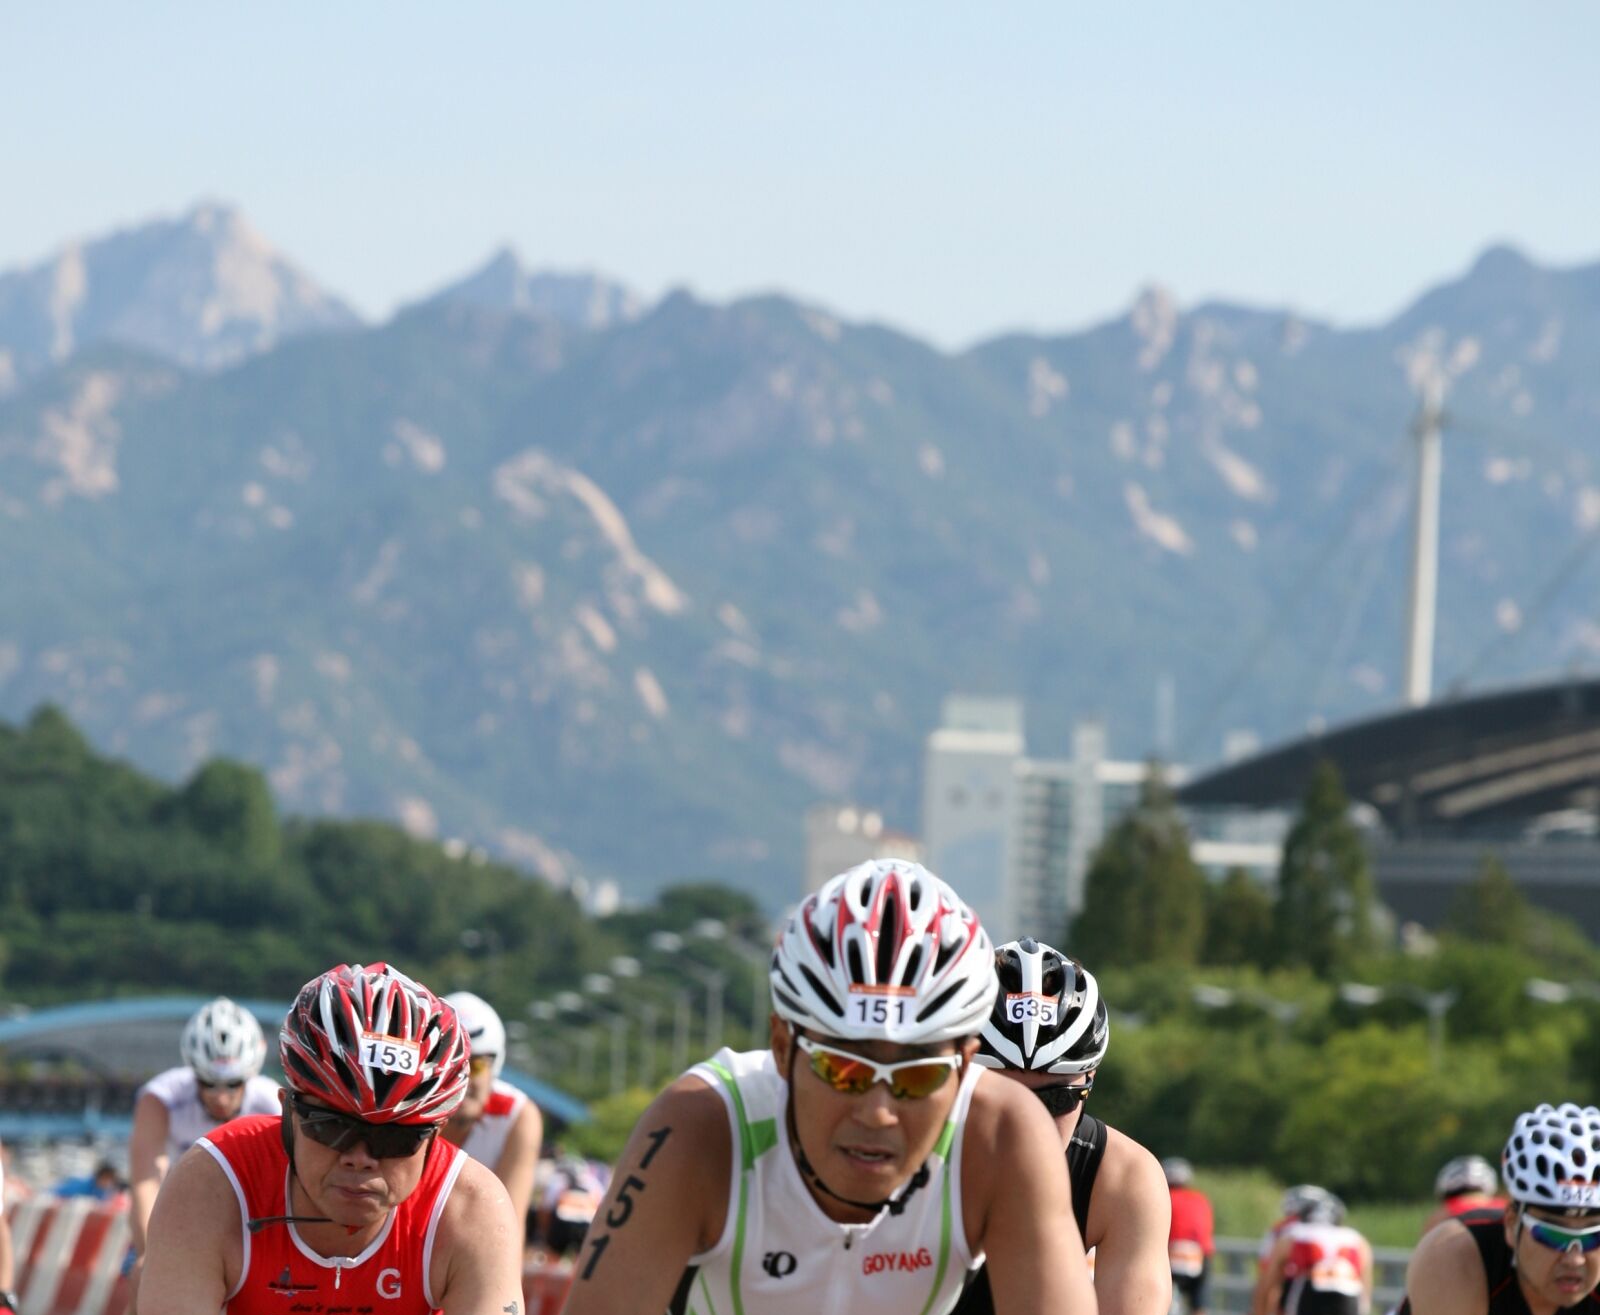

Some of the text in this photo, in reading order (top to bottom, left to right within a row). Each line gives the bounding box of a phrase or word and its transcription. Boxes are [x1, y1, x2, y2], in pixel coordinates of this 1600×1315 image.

[857, 998, 905, 1024] 151
[1012, 999, 1052, 1022] 635
[367, 1043, 412, 1070] 153
[581, 1126, 672, 1281] 151
[863, 1247, 932, 1275] GOYANG
